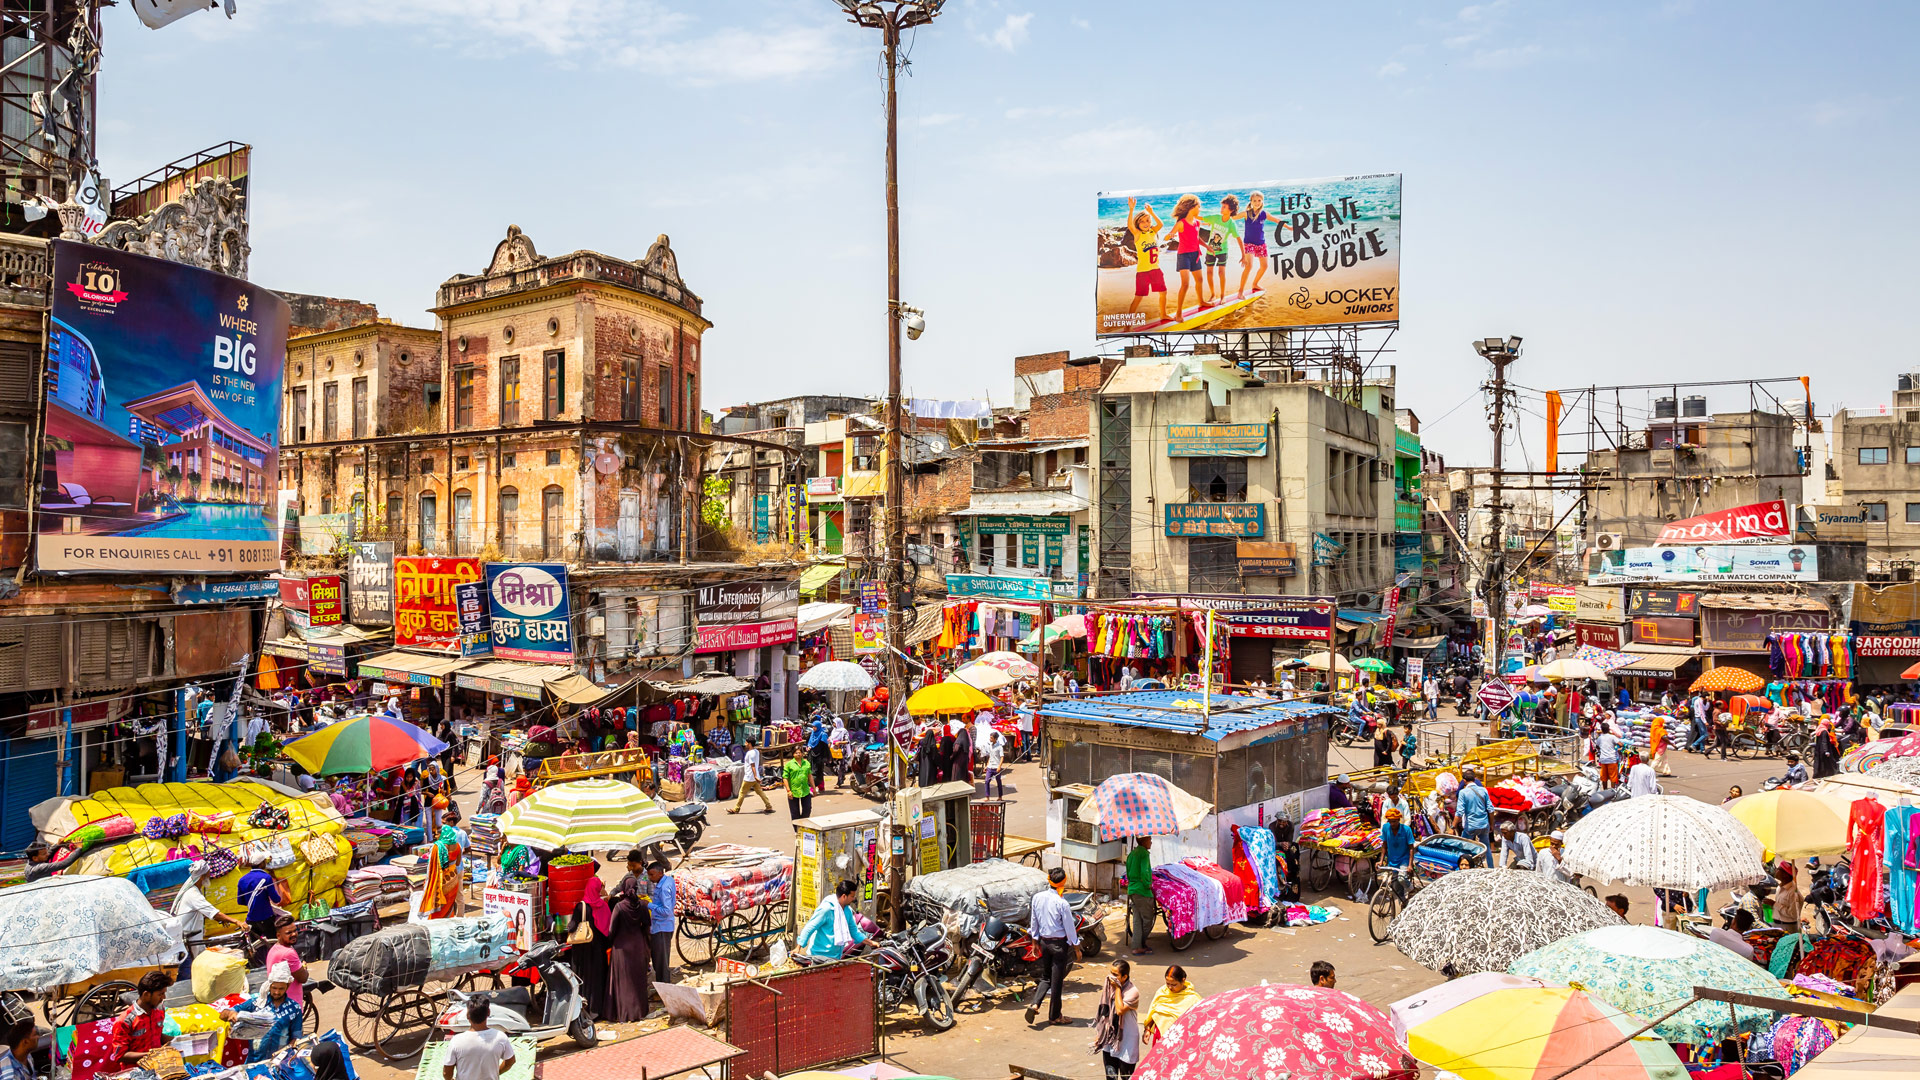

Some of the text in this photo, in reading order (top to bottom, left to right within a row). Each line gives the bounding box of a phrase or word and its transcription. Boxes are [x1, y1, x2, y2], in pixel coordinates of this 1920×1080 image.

[1280, 192, 1312, 216] LET'S
[1274, 196, 1362, 247] CREATE
[1321, 223, 1358, 250] SOME
[1270, 228, 1388, 280] TROUBLE
[84, 272, 114, 293] 10
[83, 292, 114, 302] GLORIOUS
[1316, 286, 1396, 305] JOCKEY
[87, 306, 115, 314] EXCELLENCE
[1103, 312, 1146, 320] INNERWEAR
[1343, 303, 1394, 316] JUNIORS
[220, 312, 258, 336] WHERE
[1103, 319, 1146, 328] OUTERWEAR
[214, 334, 256, 376] BIG
[212, 374, 256, 392] IS THE NEW
[210, 388, 256, 406] WAY OF LIFE
[1170, 425, 1264, 437] POORVI PHARMACEUTICALS
[1170, 506, 1258, 518] N.K. BHARGAVA MEDICINES
[1818, 512, 1863, 524] Siyarams
[1663, 510, 1784, 540] maxima
[64, 548, 94, 559] FOR
[100, 548, 170, 560] ENQUIRIES
[174, 549, 202, 560] CALL
[208, 548, 232, 562] +91
[362, 544, 377, 560] न्यू
[352, 556, 388, 586] मिश्रा
[311, 583, 338, 600] मिश्रा
[499, 572, 554, 606] मिश्रा
[971, 580, 1024, 592] SHRIJI CARDS
[699, 588, 716, 606] M.I.
[1580, 600, 1605, 609] fastrack
[315, 602, 336, 614] बुक
[311, 614, 340, 624] हाउस
[399, 608, 461, 639] बुक हाउ
[1756, 614, 1827, 628] TITAN
[492, 617, 568, 644] बुक हाउस
[1252, 625, 1328, 638] मेडिसिन्स
[1593, 632, 1614, 642] TITAN
[698, 631, 726, 648] AHSAN
[1862, 648, 1920, 656] CLOTH HOUSE
[485, 893, 496, 903] राहुल
